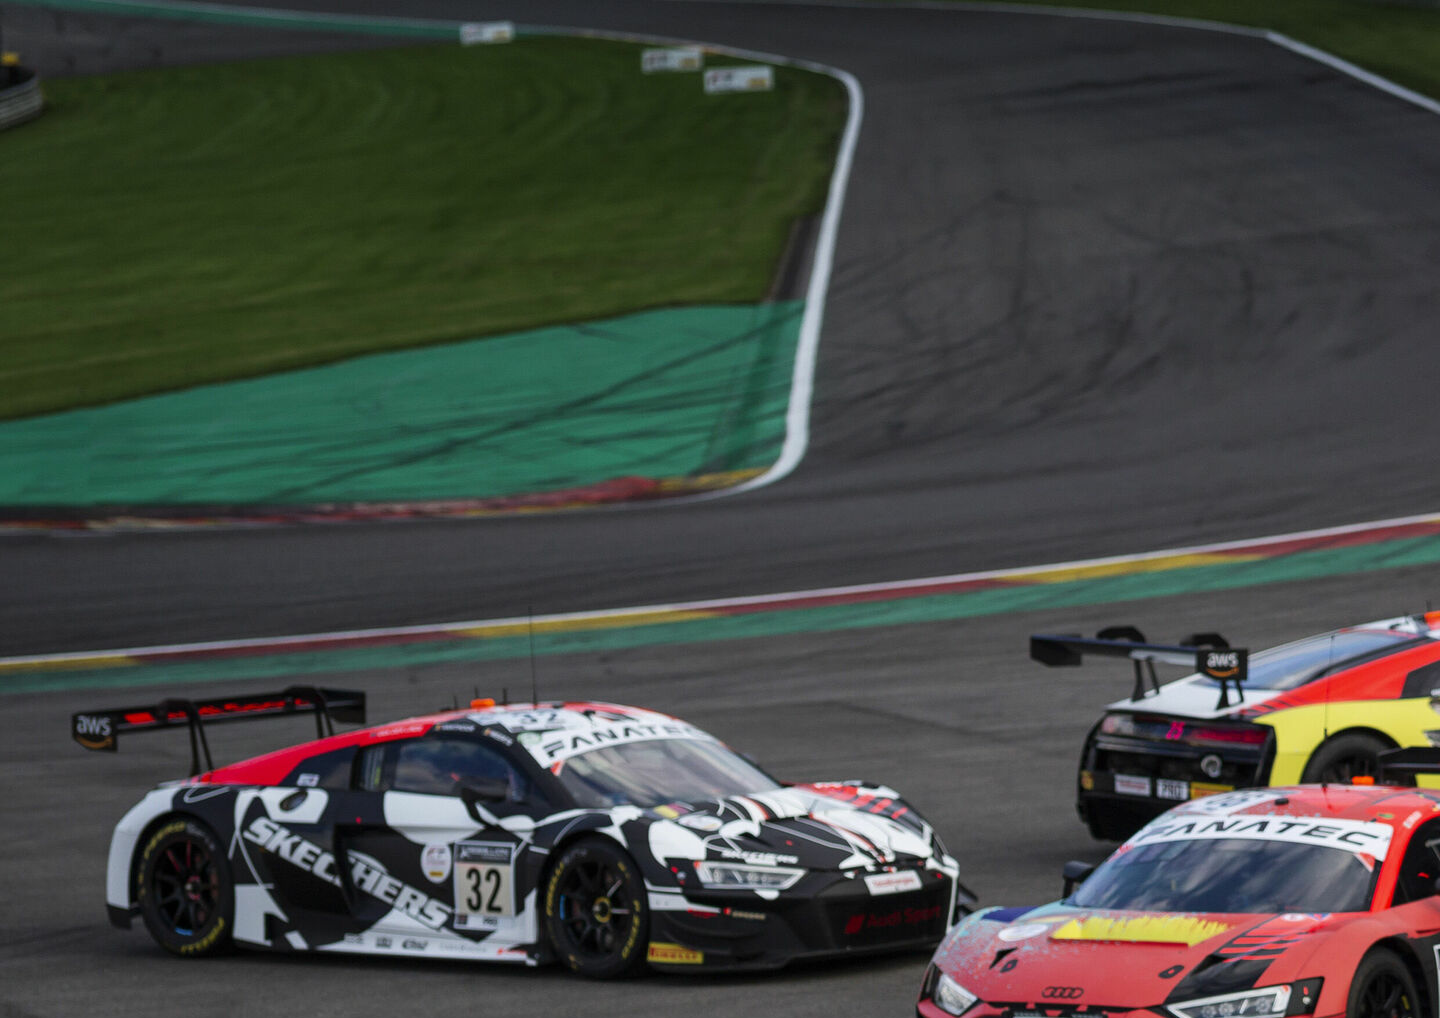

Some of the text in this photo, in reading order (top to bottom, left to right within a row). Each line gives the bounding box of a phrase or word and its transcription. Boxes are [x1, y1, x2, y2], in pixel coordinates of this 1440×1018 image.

[1207, 652, 1239, 668] aws
[77, 715, 112, 736] aws
[543, 724, 694, 758] FANATE
[1137, 819, 1381, 846] FANATEC
[243, 816, 453, 930] SKECHERS
[466, 867, 502, 914] 32
